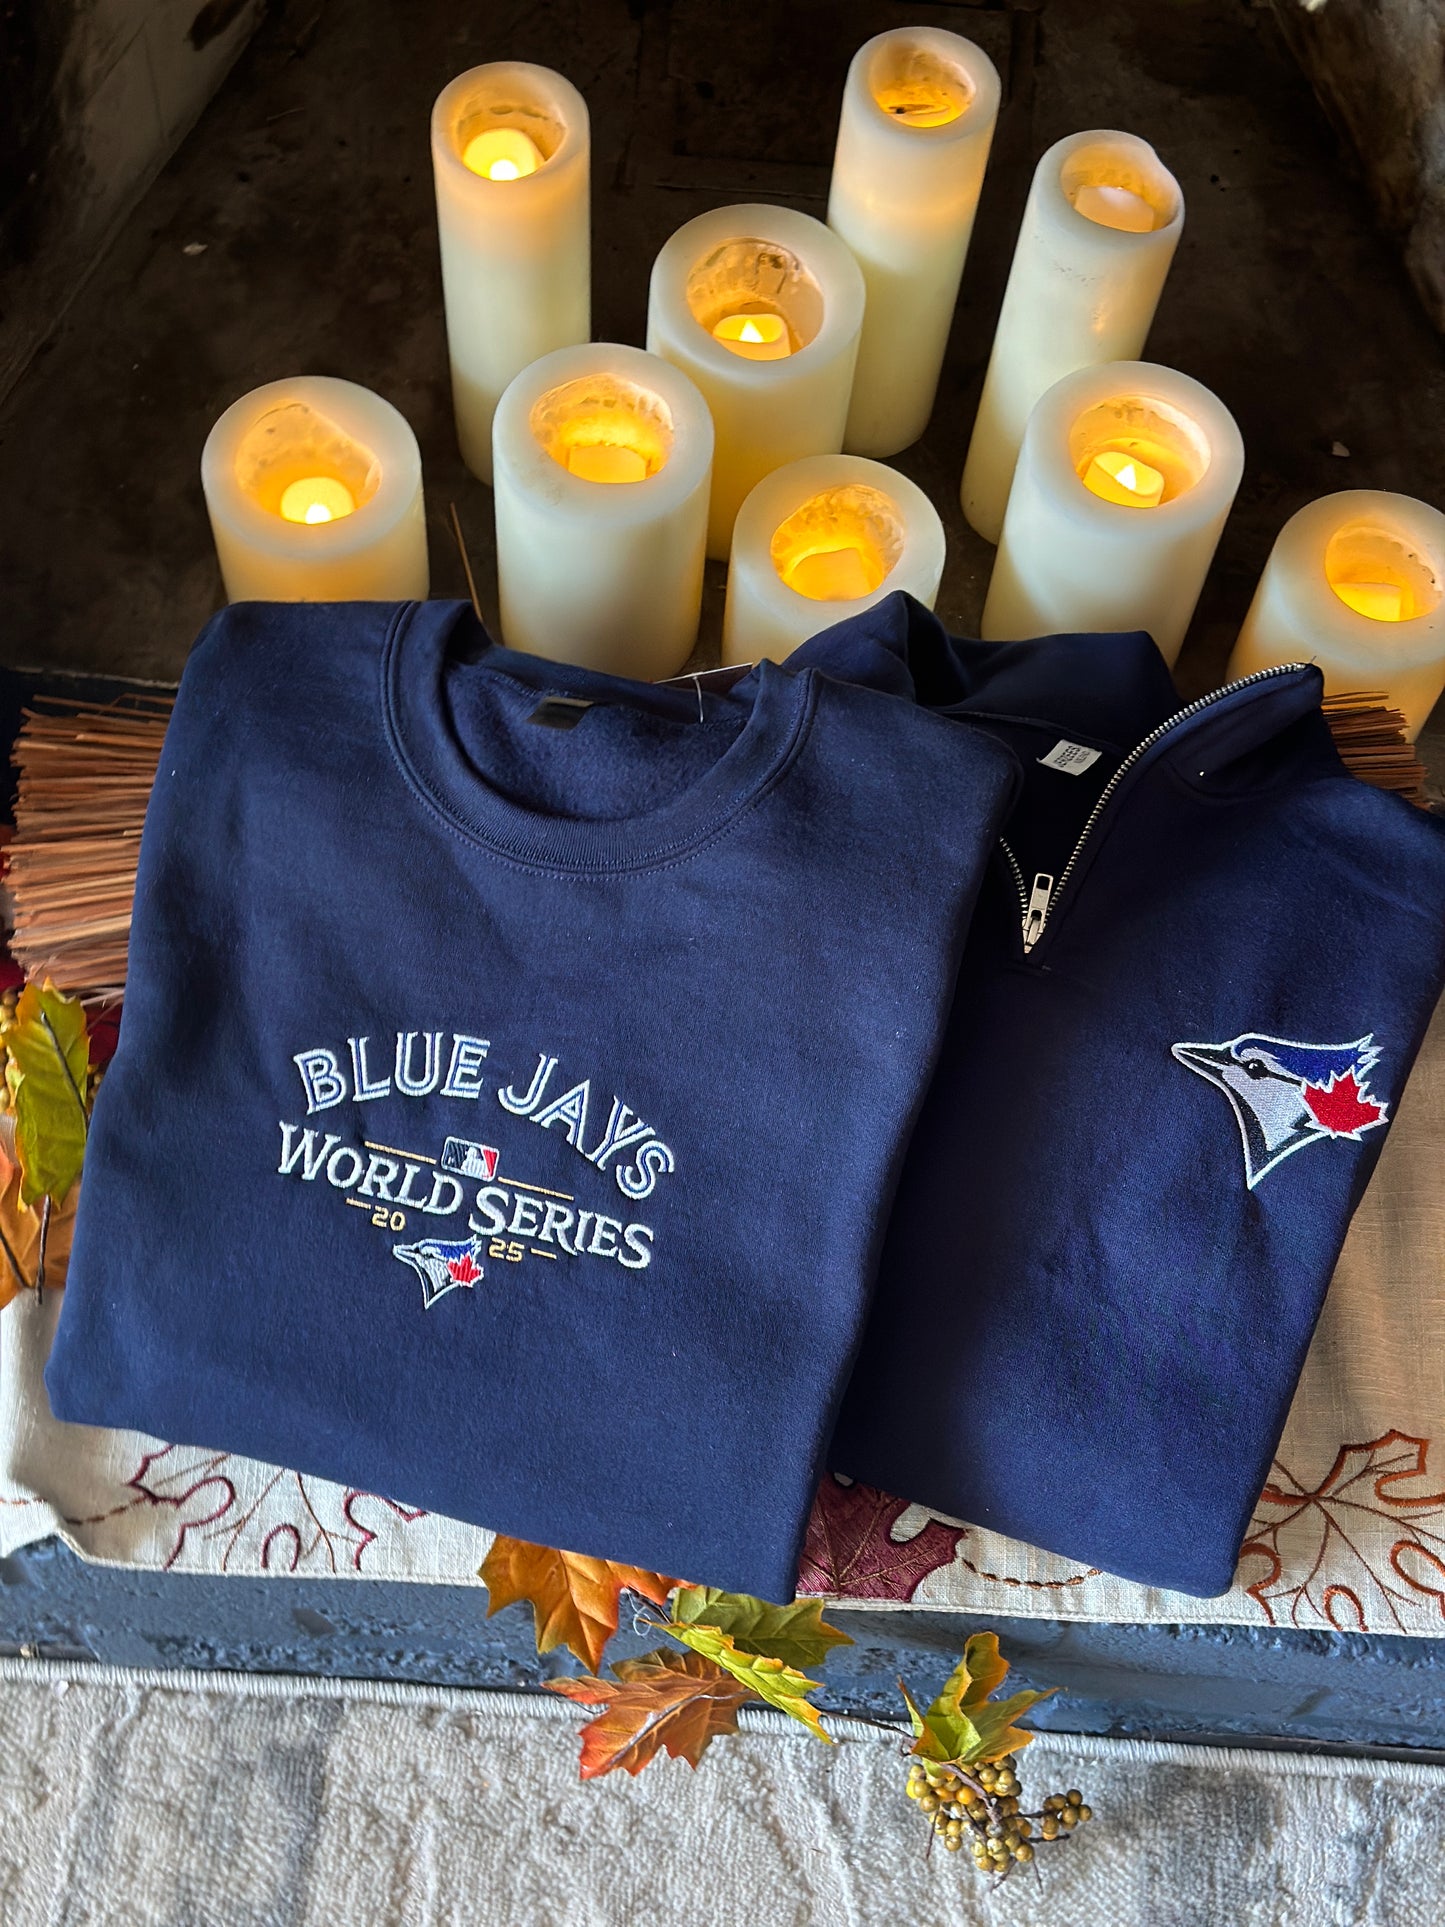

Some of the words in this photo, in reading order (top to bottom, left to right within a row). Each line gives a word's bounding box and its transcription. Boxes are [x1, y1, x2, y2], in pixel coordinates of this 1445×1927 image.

[293, 1031, 490, 1115] BLUE
[498, 1053, 675, 1200] JAYS
[278, 1120, 463, 1215] WORLD
[468, 1186, 654, 1270] SERIES
[371, 1204, 406, 1231] 20
[488, 1237, 523, 1263] 25
